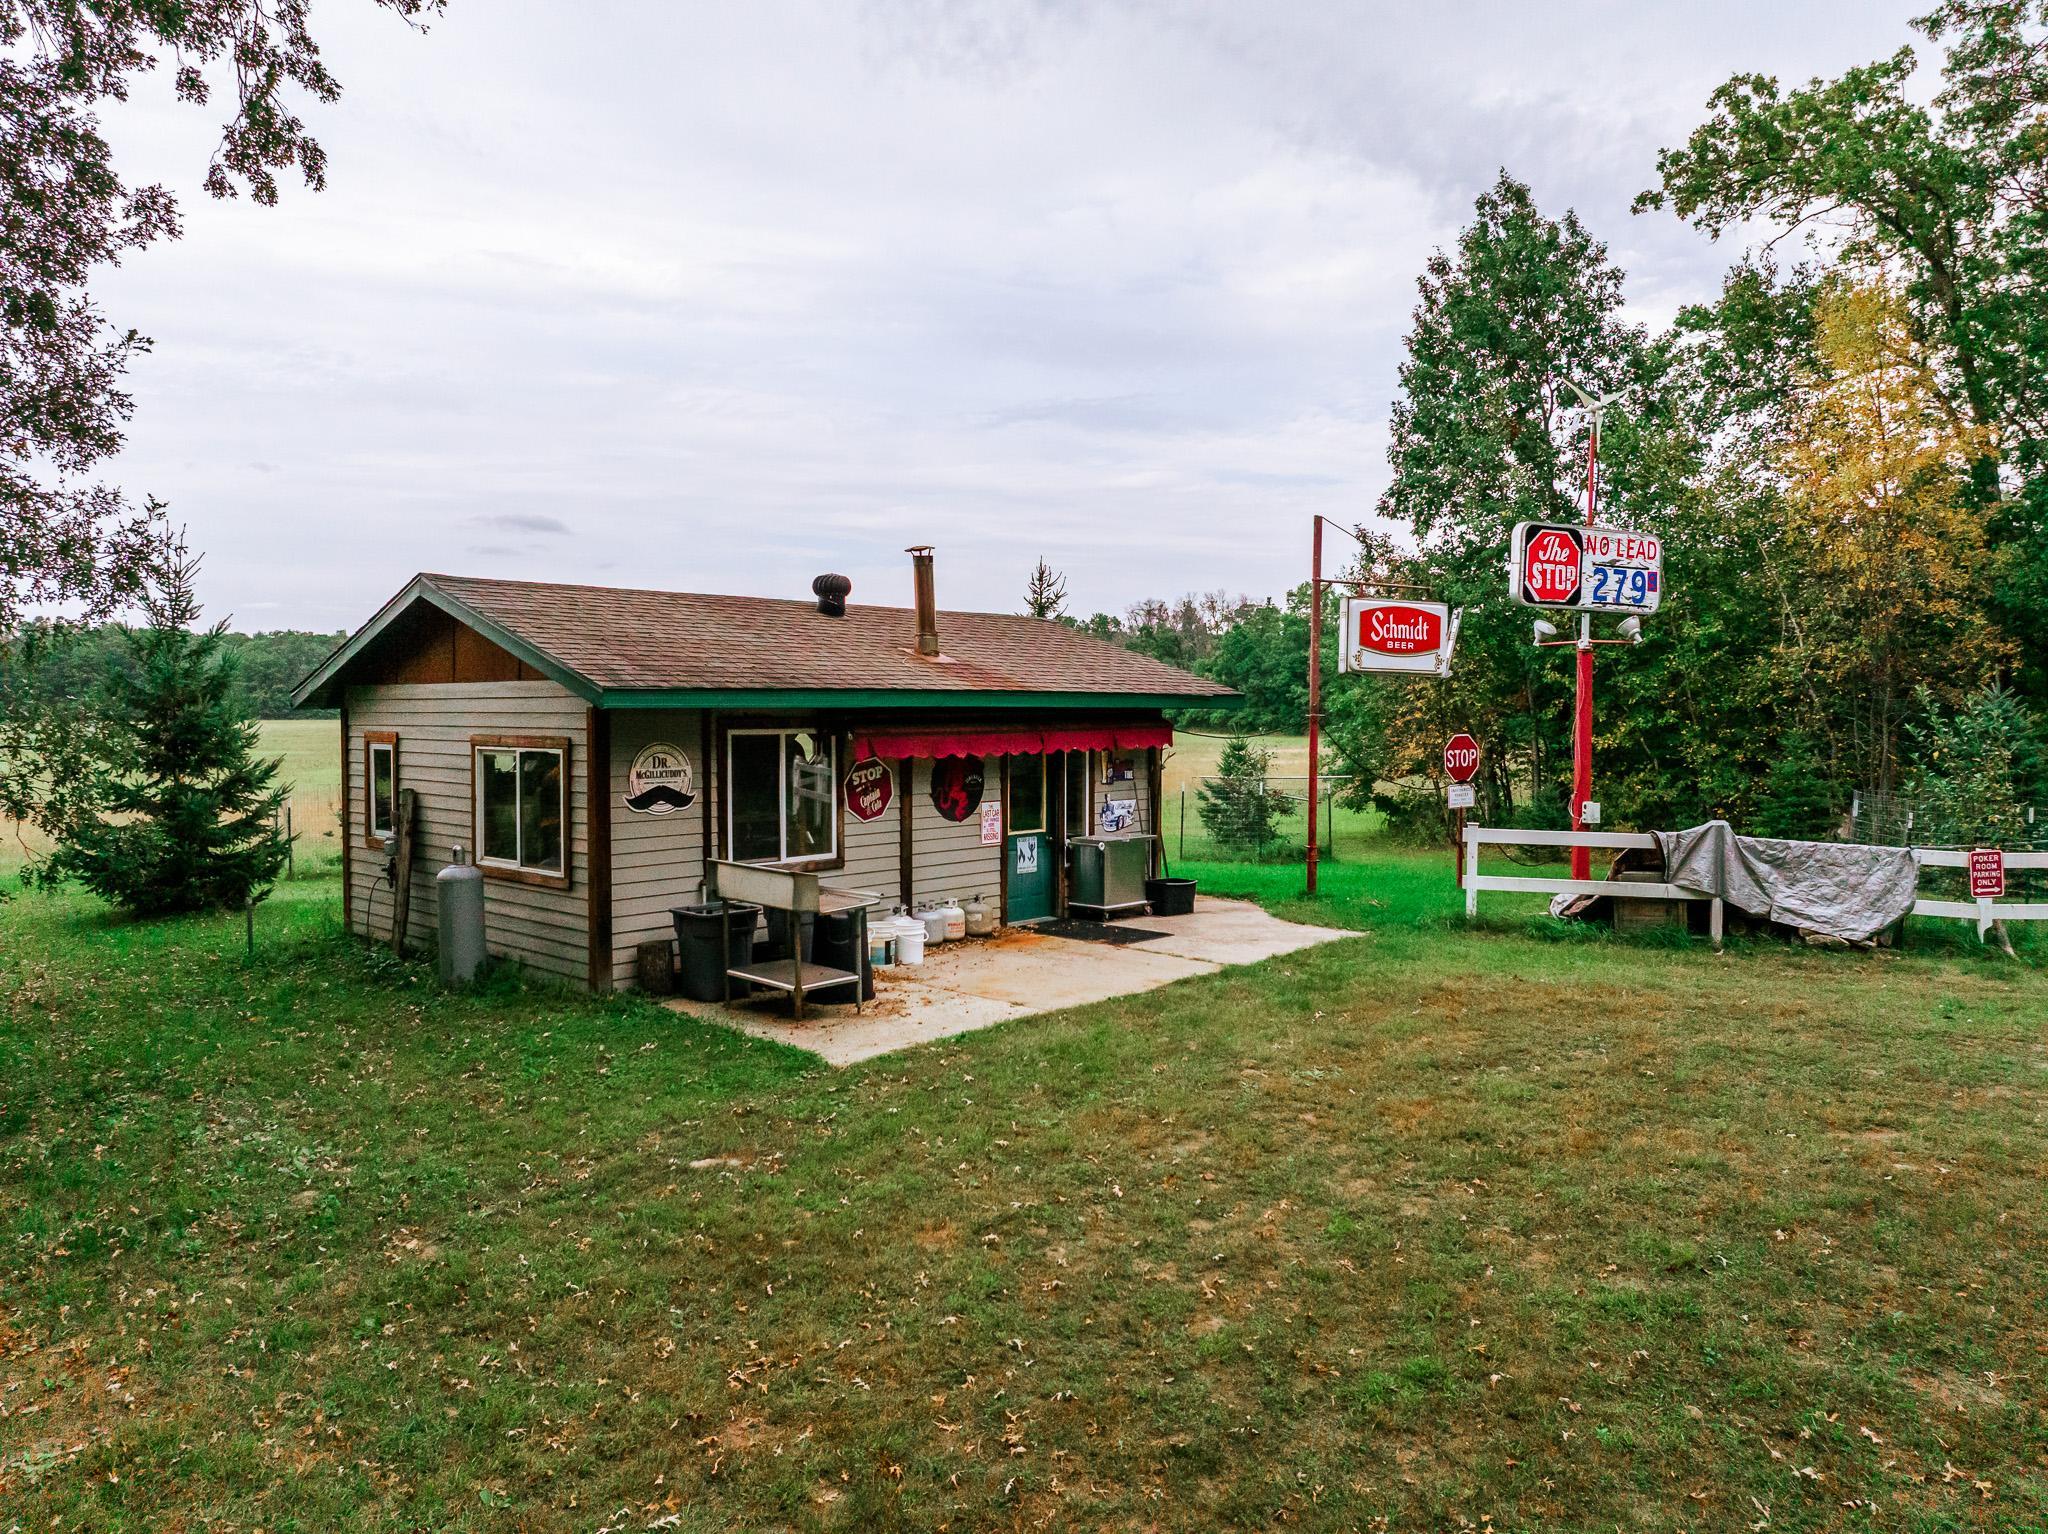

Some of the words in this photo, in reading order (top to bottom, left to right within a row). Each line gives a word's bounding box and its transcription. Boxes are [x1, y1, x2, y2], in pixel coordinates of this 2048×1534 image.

[1539, 535, 1570, 562] The
[1586, 535, 1610, 556] NO
[1617, 537, 1657, 560] LEAD
[1532, 562, 1577, 591] STOP
[1371, 610, 1430, 642] Schmidt
[1387, 641, 1414, 650] BEER
[652, 755, 671, 769] DR.
[1447, 749, 1477, 768] STOP
[852, 765, 883, 786] STOP
[983, 832, 999, 840] MISSING
